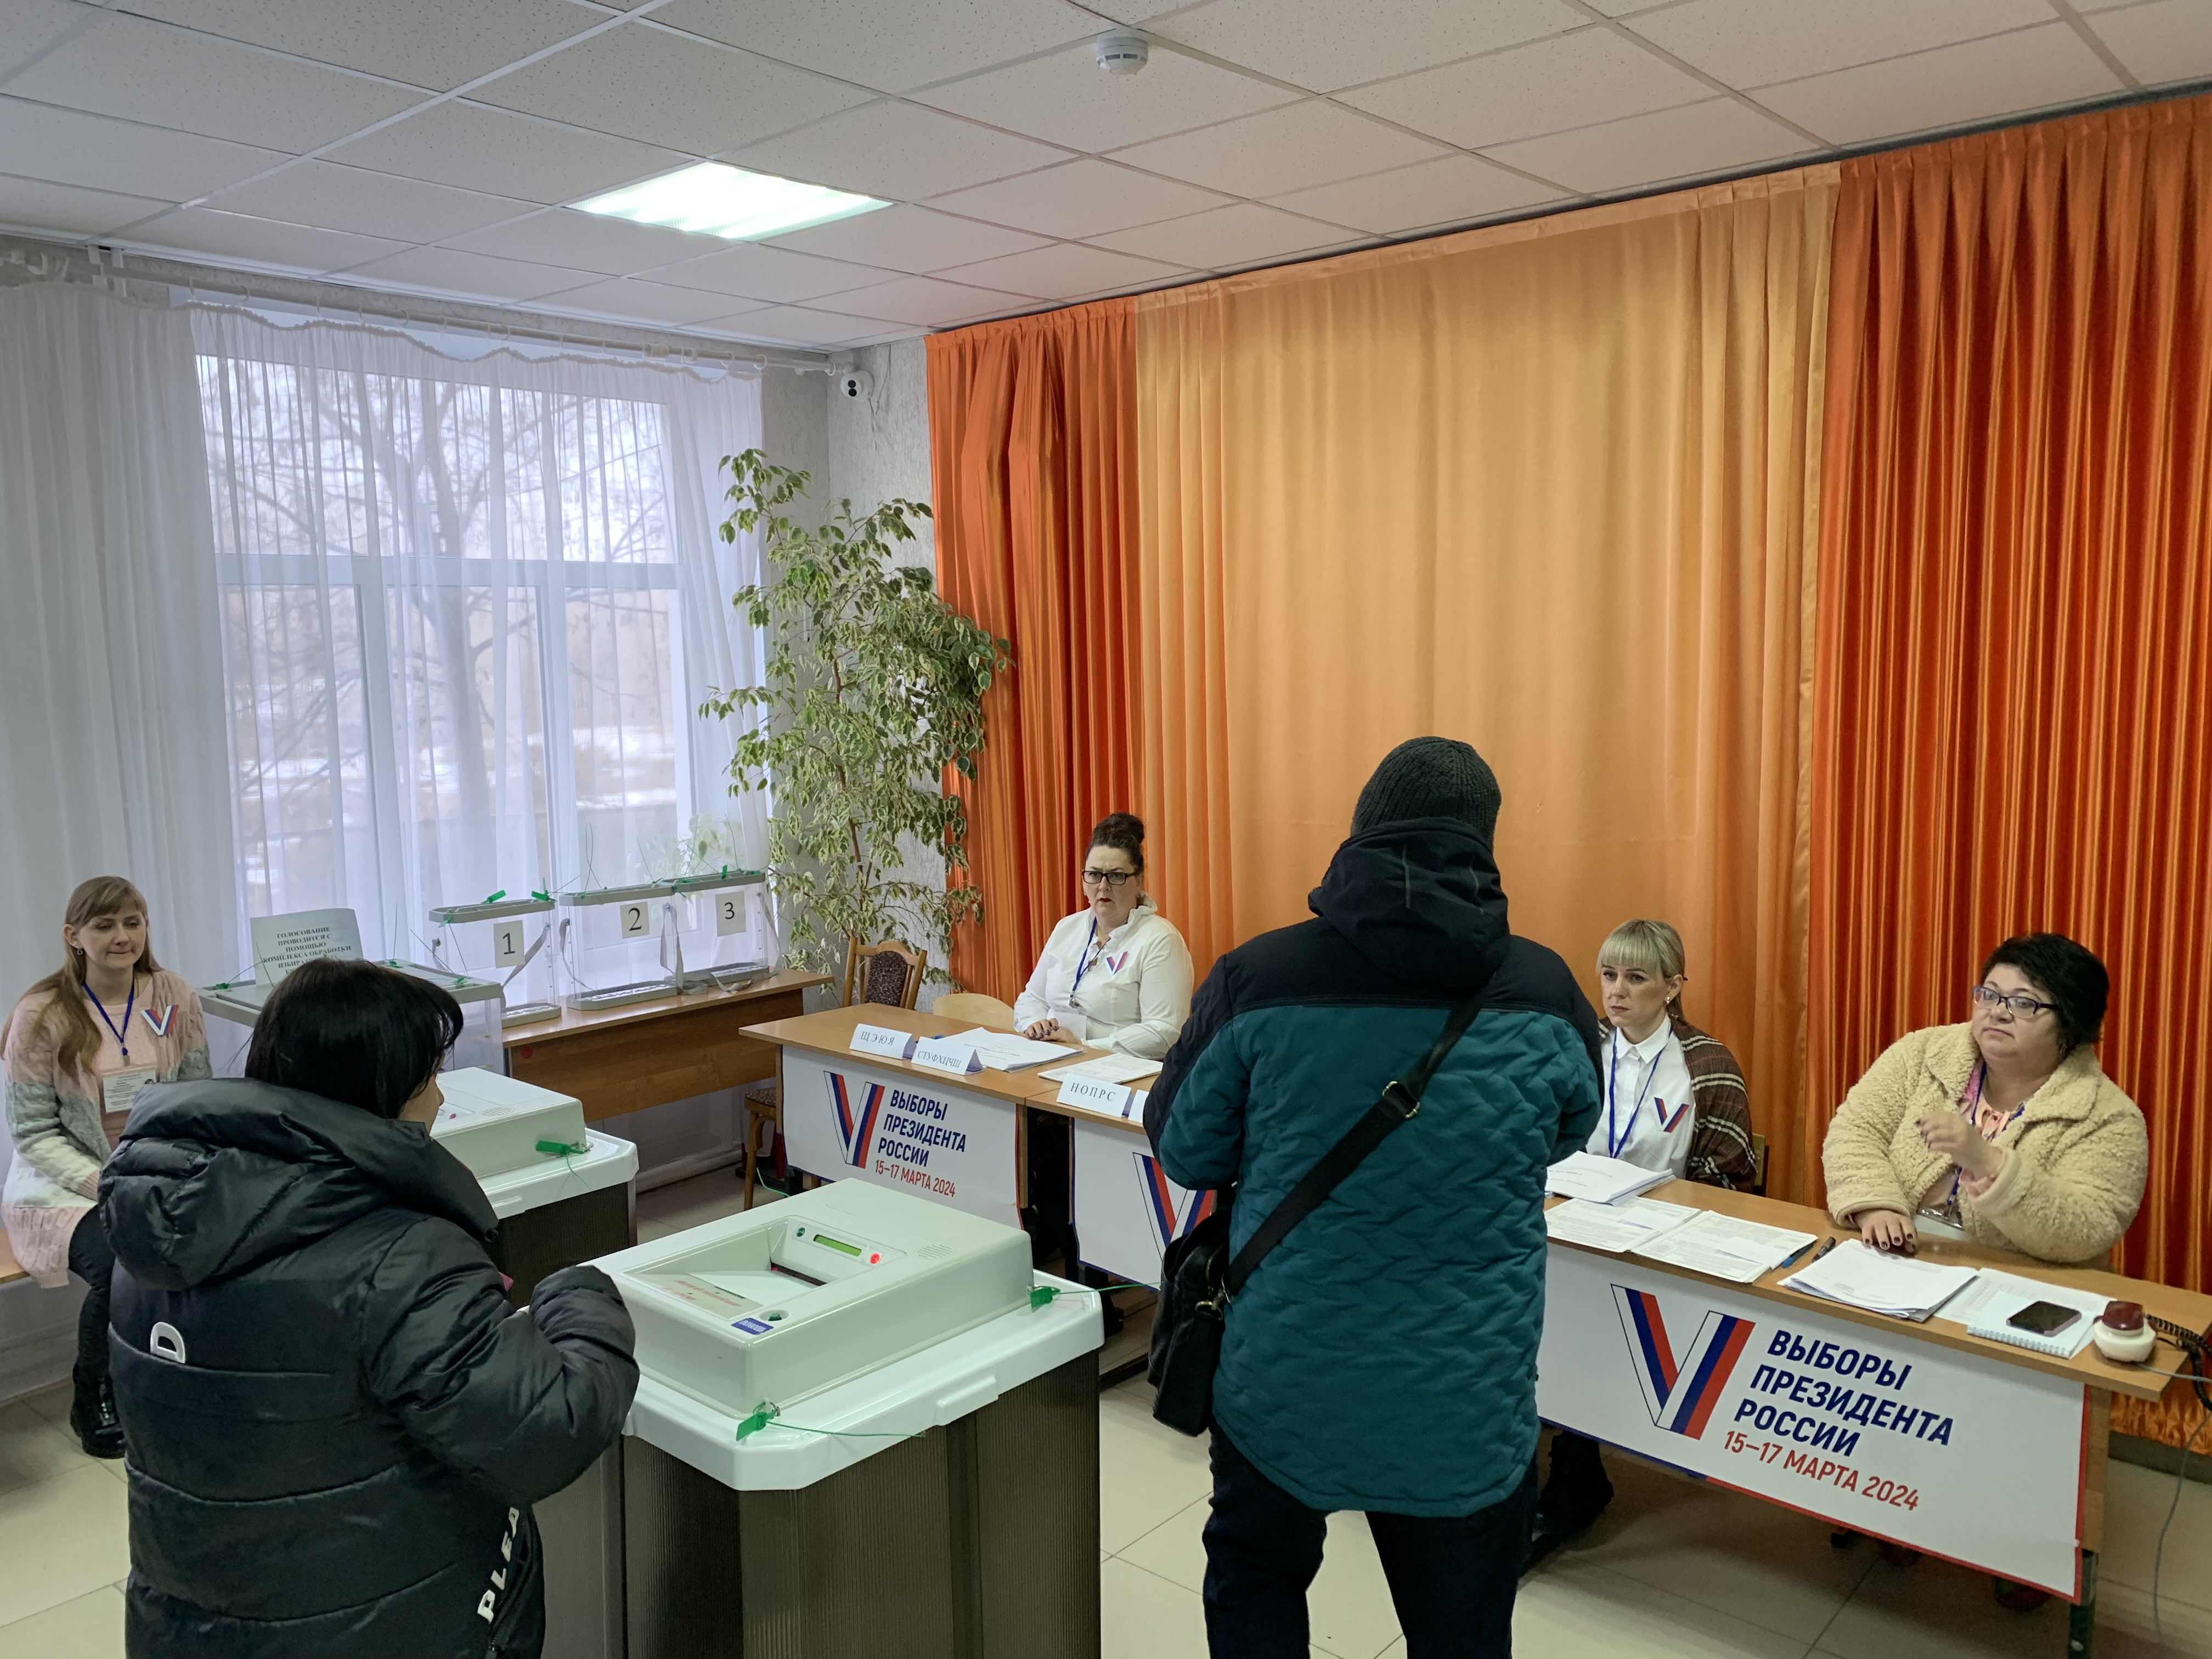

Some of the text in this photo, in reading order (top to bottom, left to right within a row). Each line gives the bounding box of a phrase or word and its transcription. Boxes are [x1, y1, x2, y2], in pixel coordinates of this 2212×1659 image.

[628, 907, 642, 932] 2
[725, 902, 735, 919] 3
[276, 926, 331, 939] ГОЛОСОВАНИЕ
[278, 935, 325, 946] ПРОВОДИТСЯ
[502, 932, 516, 955] 1
[263, 945, 352, 963] КОМПЛЕКСА ОБРАБОТКИ
[285, 942, 326, 952] ПОМОЩЬЮ
[917, 1050, 962, 1068] СТУФХЦЧШ
[889, 1089, 948, 1121] ВЫБОРЫ
[883, 1113, 966, 1153] ПРЕЗИДЕНТА
[877, 1137, 930, 1167] РОССИИ
[900, 1167, 931, 1190] МАРТА
[932, 1177, 956, 1198] 2024
[1767, 1329, 1912, 1391] ВЫБОРЫ
[1750, 1363, 1954, 1446] ПРЕЗИДЕНТА
[1733, 1398, 1861, 1457] РОССИИ
[1782, 1449, 1859, 1492] МАРТА
[1861, 1476, 1919, 1511] 2024
